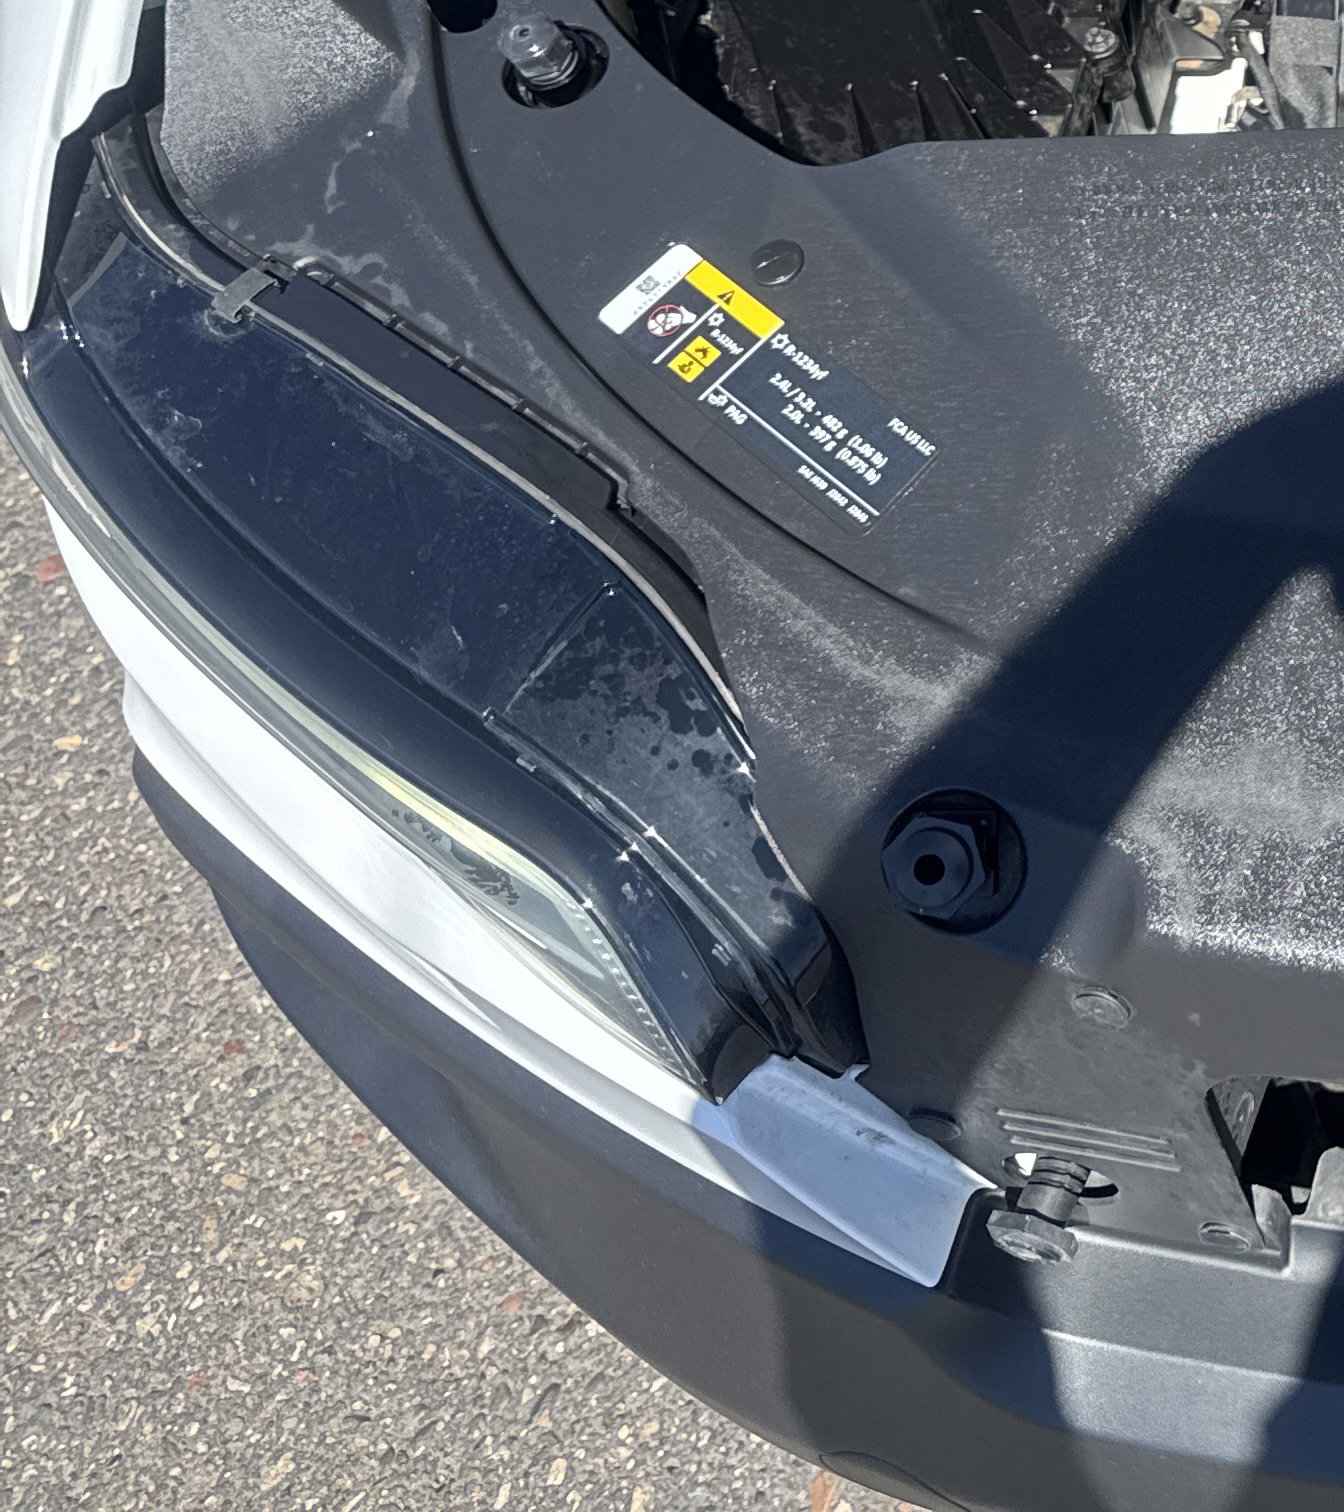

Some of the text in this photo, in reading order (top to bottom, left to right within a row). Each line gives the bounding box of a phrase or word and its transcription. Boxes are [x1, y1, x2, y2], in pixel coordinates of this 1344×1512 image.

[782, 344, 829, 380] R-1234yf
[768, 373, 793, 393] 2.4L
[723, 404, 748, 426] PAG
[781, 404, 806, 424] 2.0L
[886, 418, 937, 456] FCA US LLC
